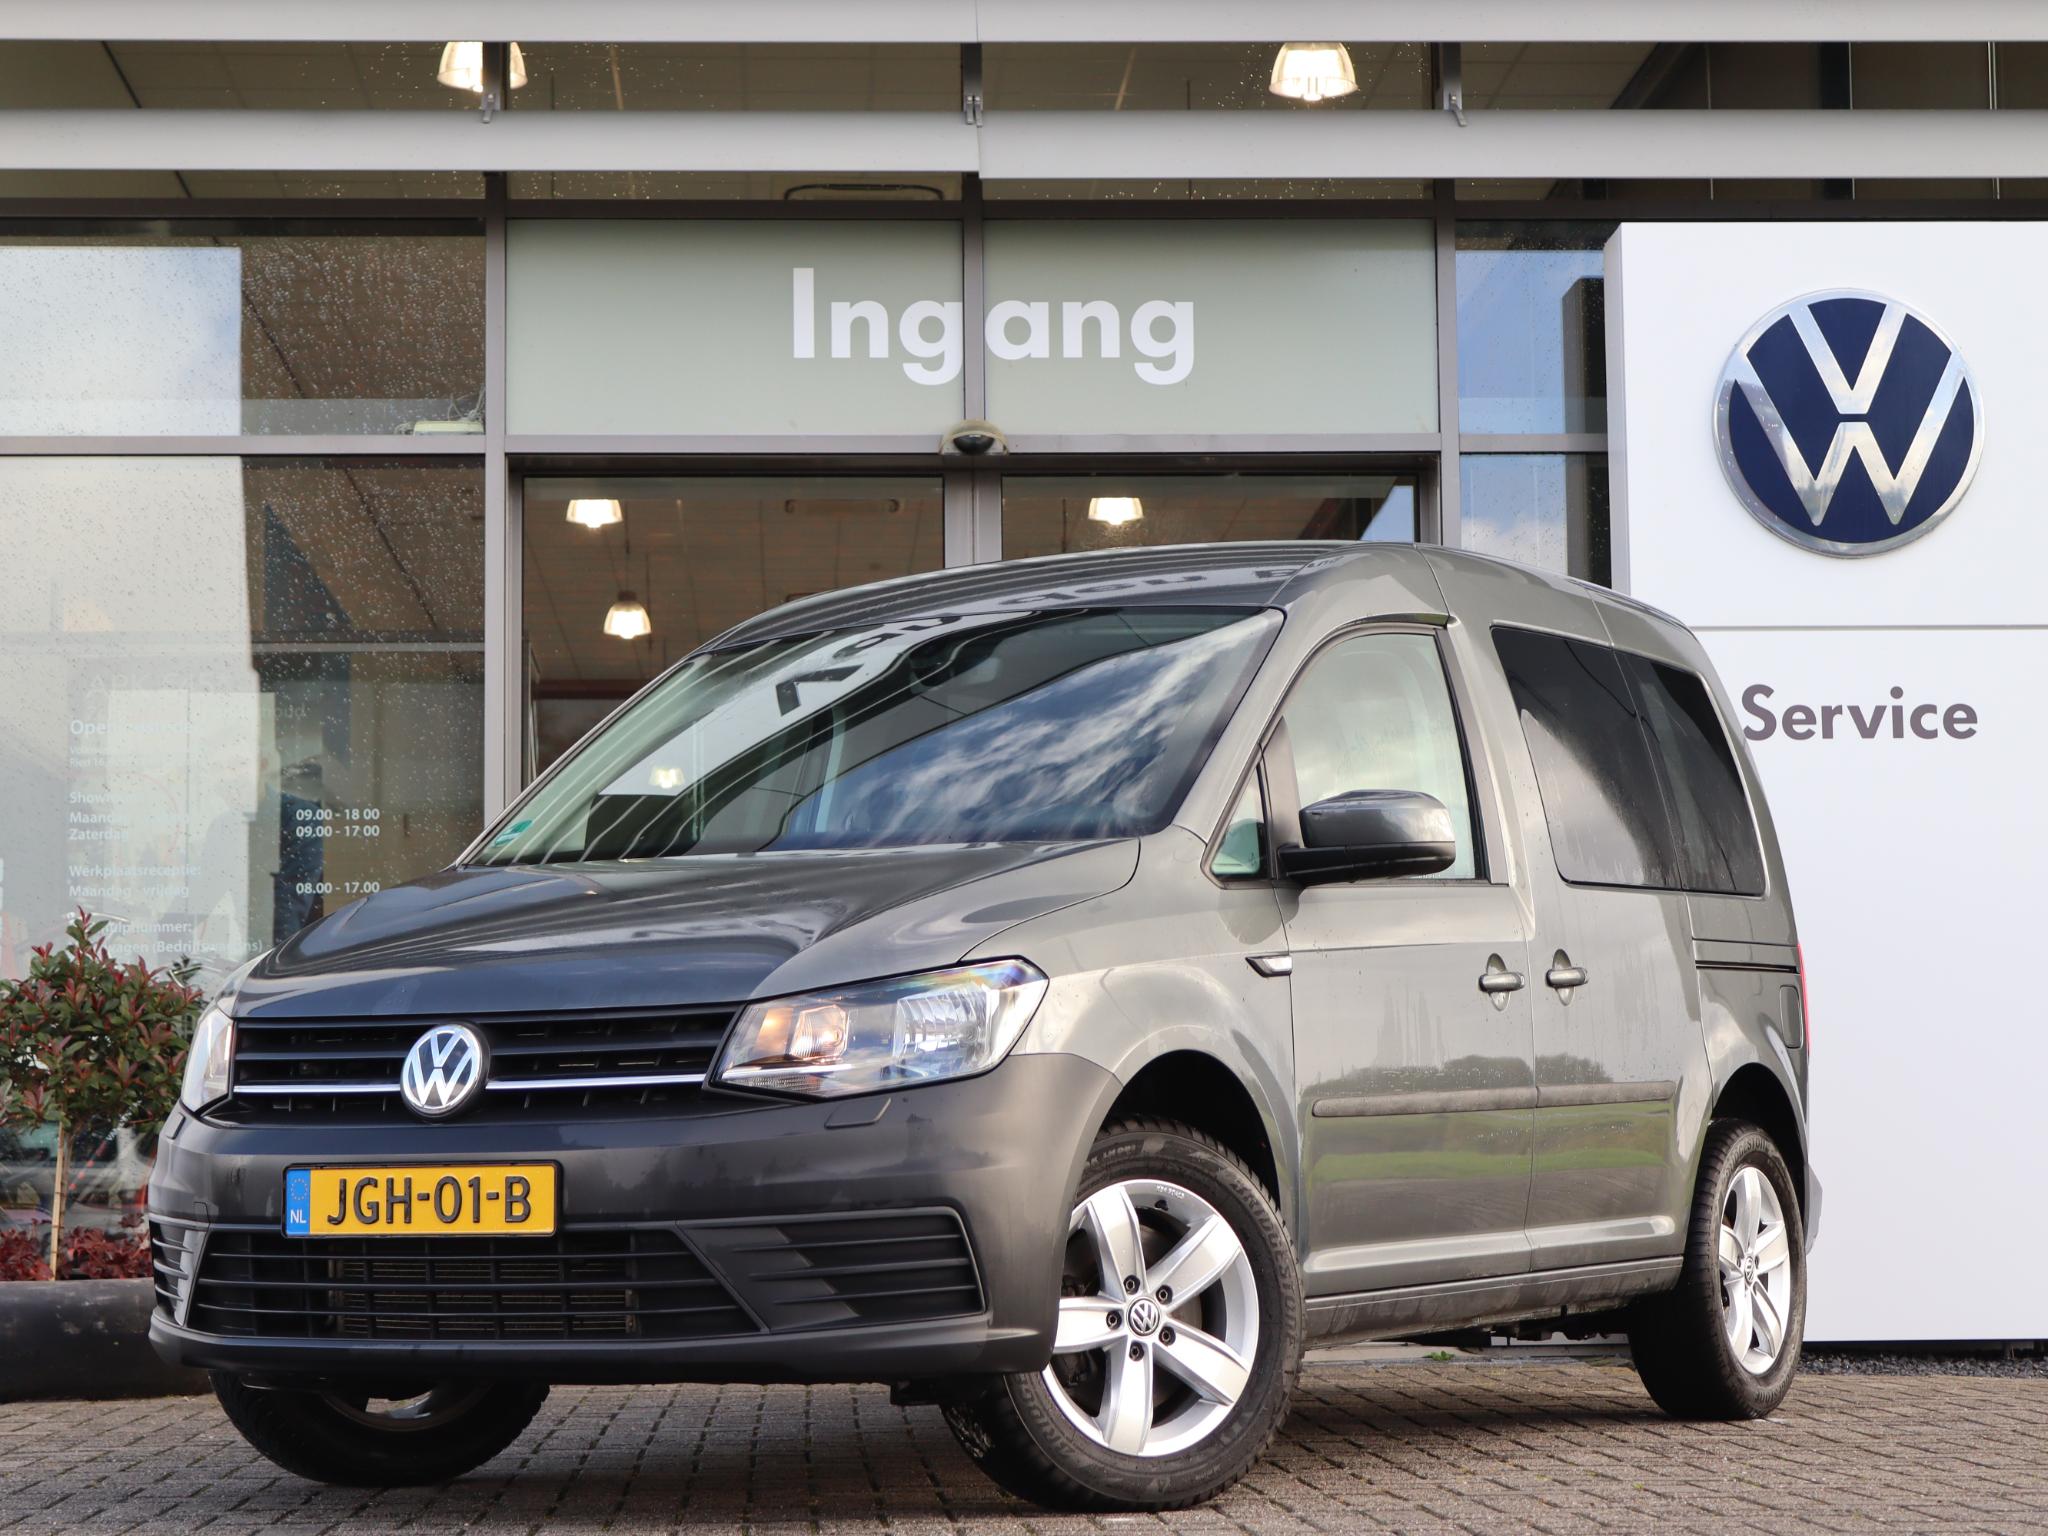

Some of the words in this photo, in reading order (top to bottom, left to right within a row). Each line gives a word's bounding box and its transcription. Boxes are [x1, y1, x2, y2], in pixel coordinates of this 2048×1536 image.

[793, 267, 1195, 386] Ingang
[1742, 683, 1979, 741] Service
[296, 808, 333, 821] 09.00
[296, 825, 333, 837] 09.00
[296, 882, 333, 894] 08.00
[344, 882, 380, 893] 17.00
[326, 1175, 532, 1226] JGH-01-B
[289, 1208, 307, 1225] NL
